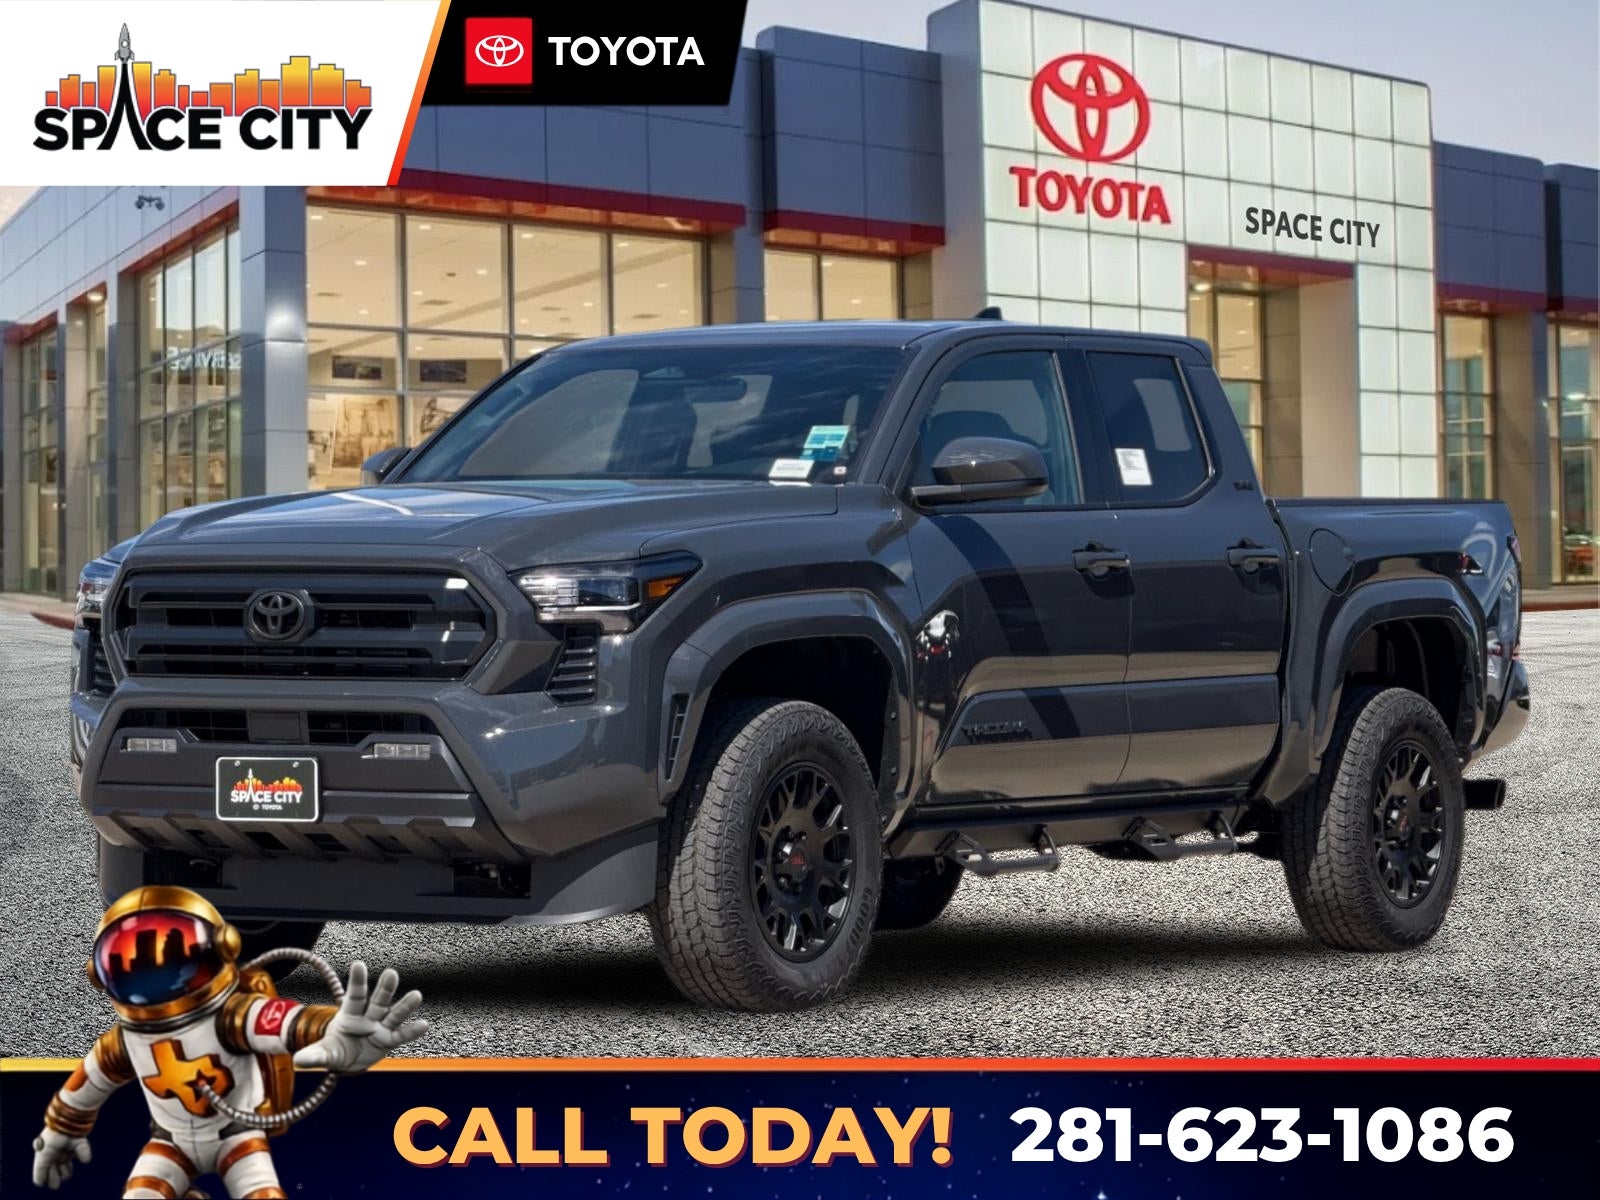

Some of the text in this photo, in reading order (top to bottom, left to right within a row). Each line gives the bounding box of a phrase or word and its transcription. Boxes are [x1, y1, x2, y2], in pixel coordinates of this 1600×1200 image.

[1010, 166, 1171, 224] TOYOTA
[1245, 206, 1381, 248] SPACE CITY
[230, 784, 302, 804] SPACE CITY
